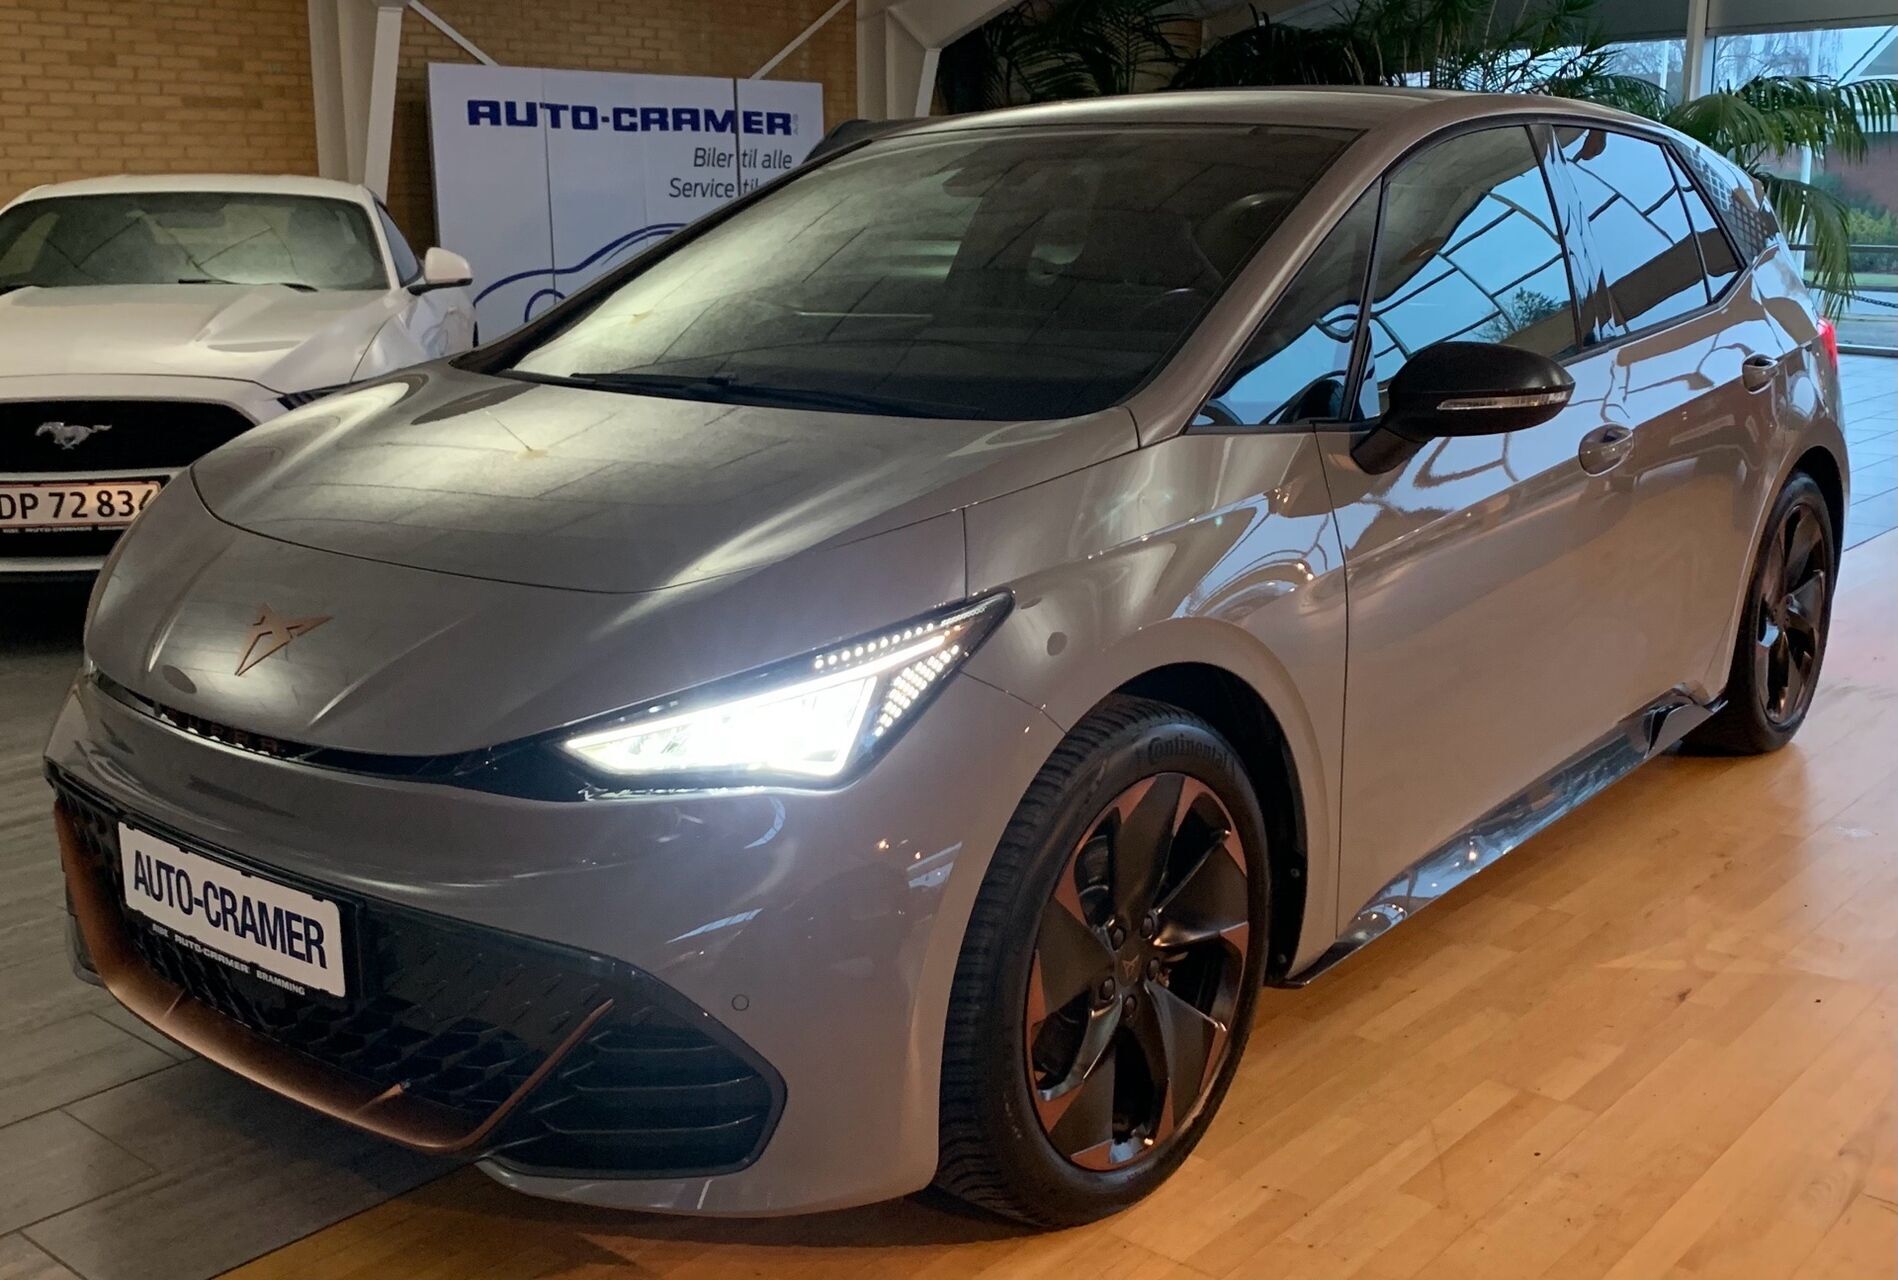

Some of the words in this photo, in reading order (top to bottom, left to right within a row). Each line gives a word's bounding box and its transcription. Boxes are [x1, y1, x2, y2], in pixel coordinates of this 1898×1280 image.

[467, 99, 792, 136] AUTO-CRAMER
[693, 147, 734, 168] Biler
[741, 148, 758, 169] til
[761, 149, 793, 170] alle
[668, 177, 735, 198] Service
[0, 493, 39, 520] DP
[48, 491, 88, 518] 72
[134, 849, 328, 970] AUTO-CRAMER
[174, 933, 250, 975] AUTO-CRAMER
[256, 969, 306, 997] BRAMMING
